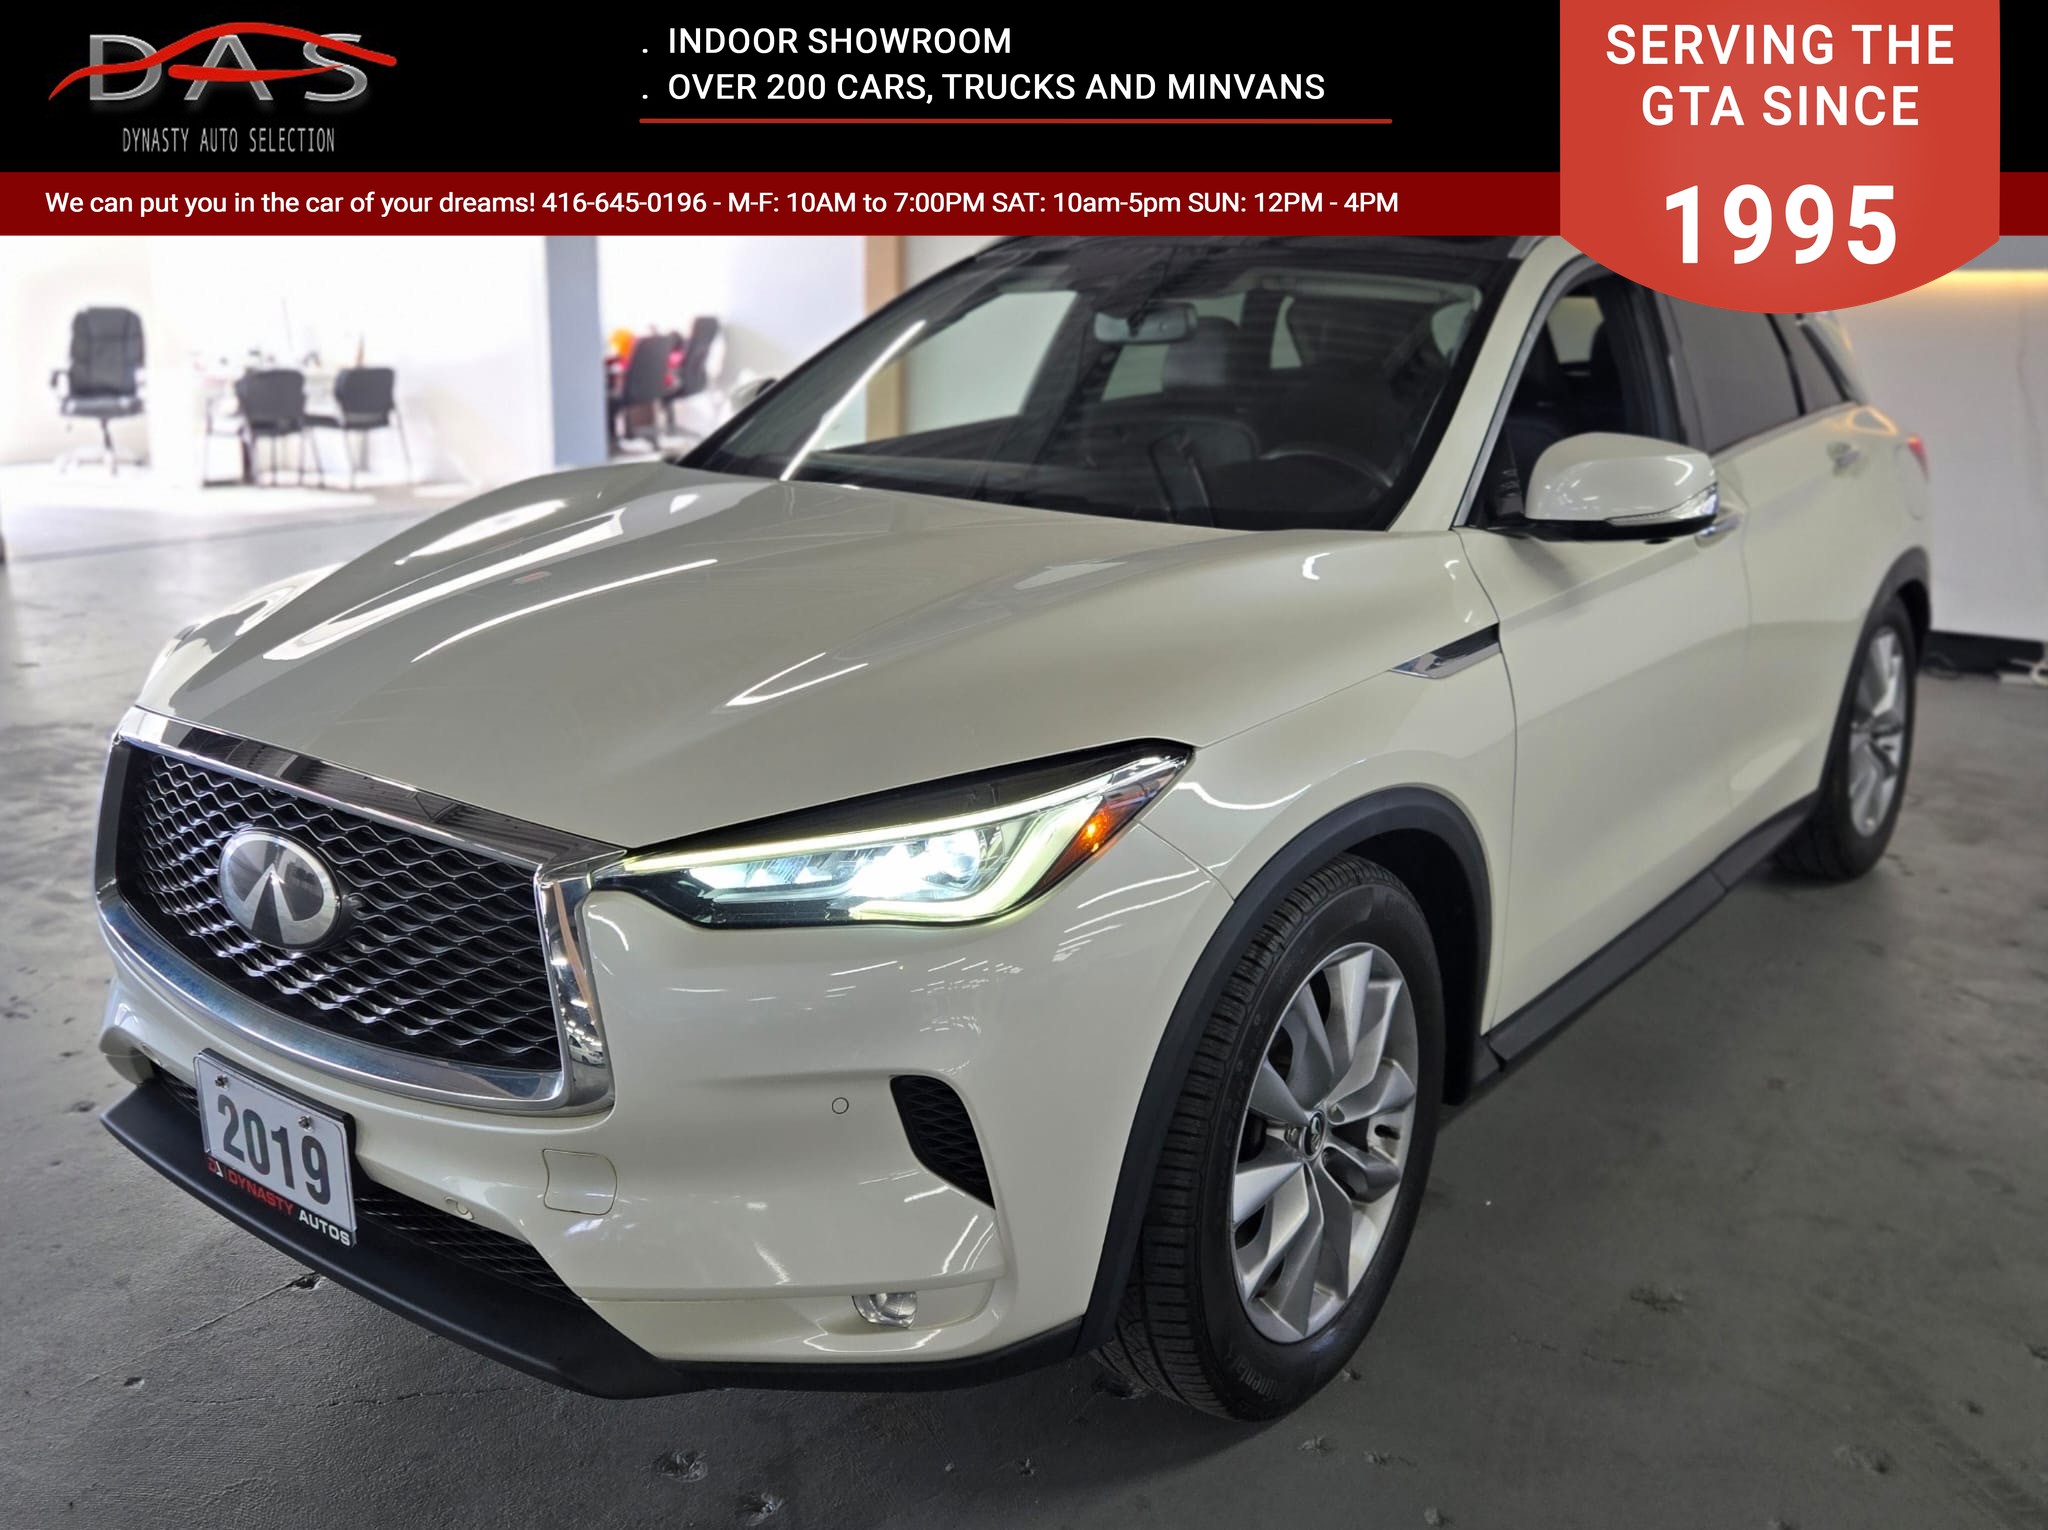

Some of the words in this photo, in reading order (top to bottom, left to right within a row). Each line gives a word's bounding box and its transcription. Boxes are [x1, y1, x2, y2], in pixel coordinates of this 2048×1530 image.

[217, 1094, 331, 1206] 2019
[228, 1168, 294, 1217] DYNASTY
[298, 1209, 351, 1247] AUTOS
